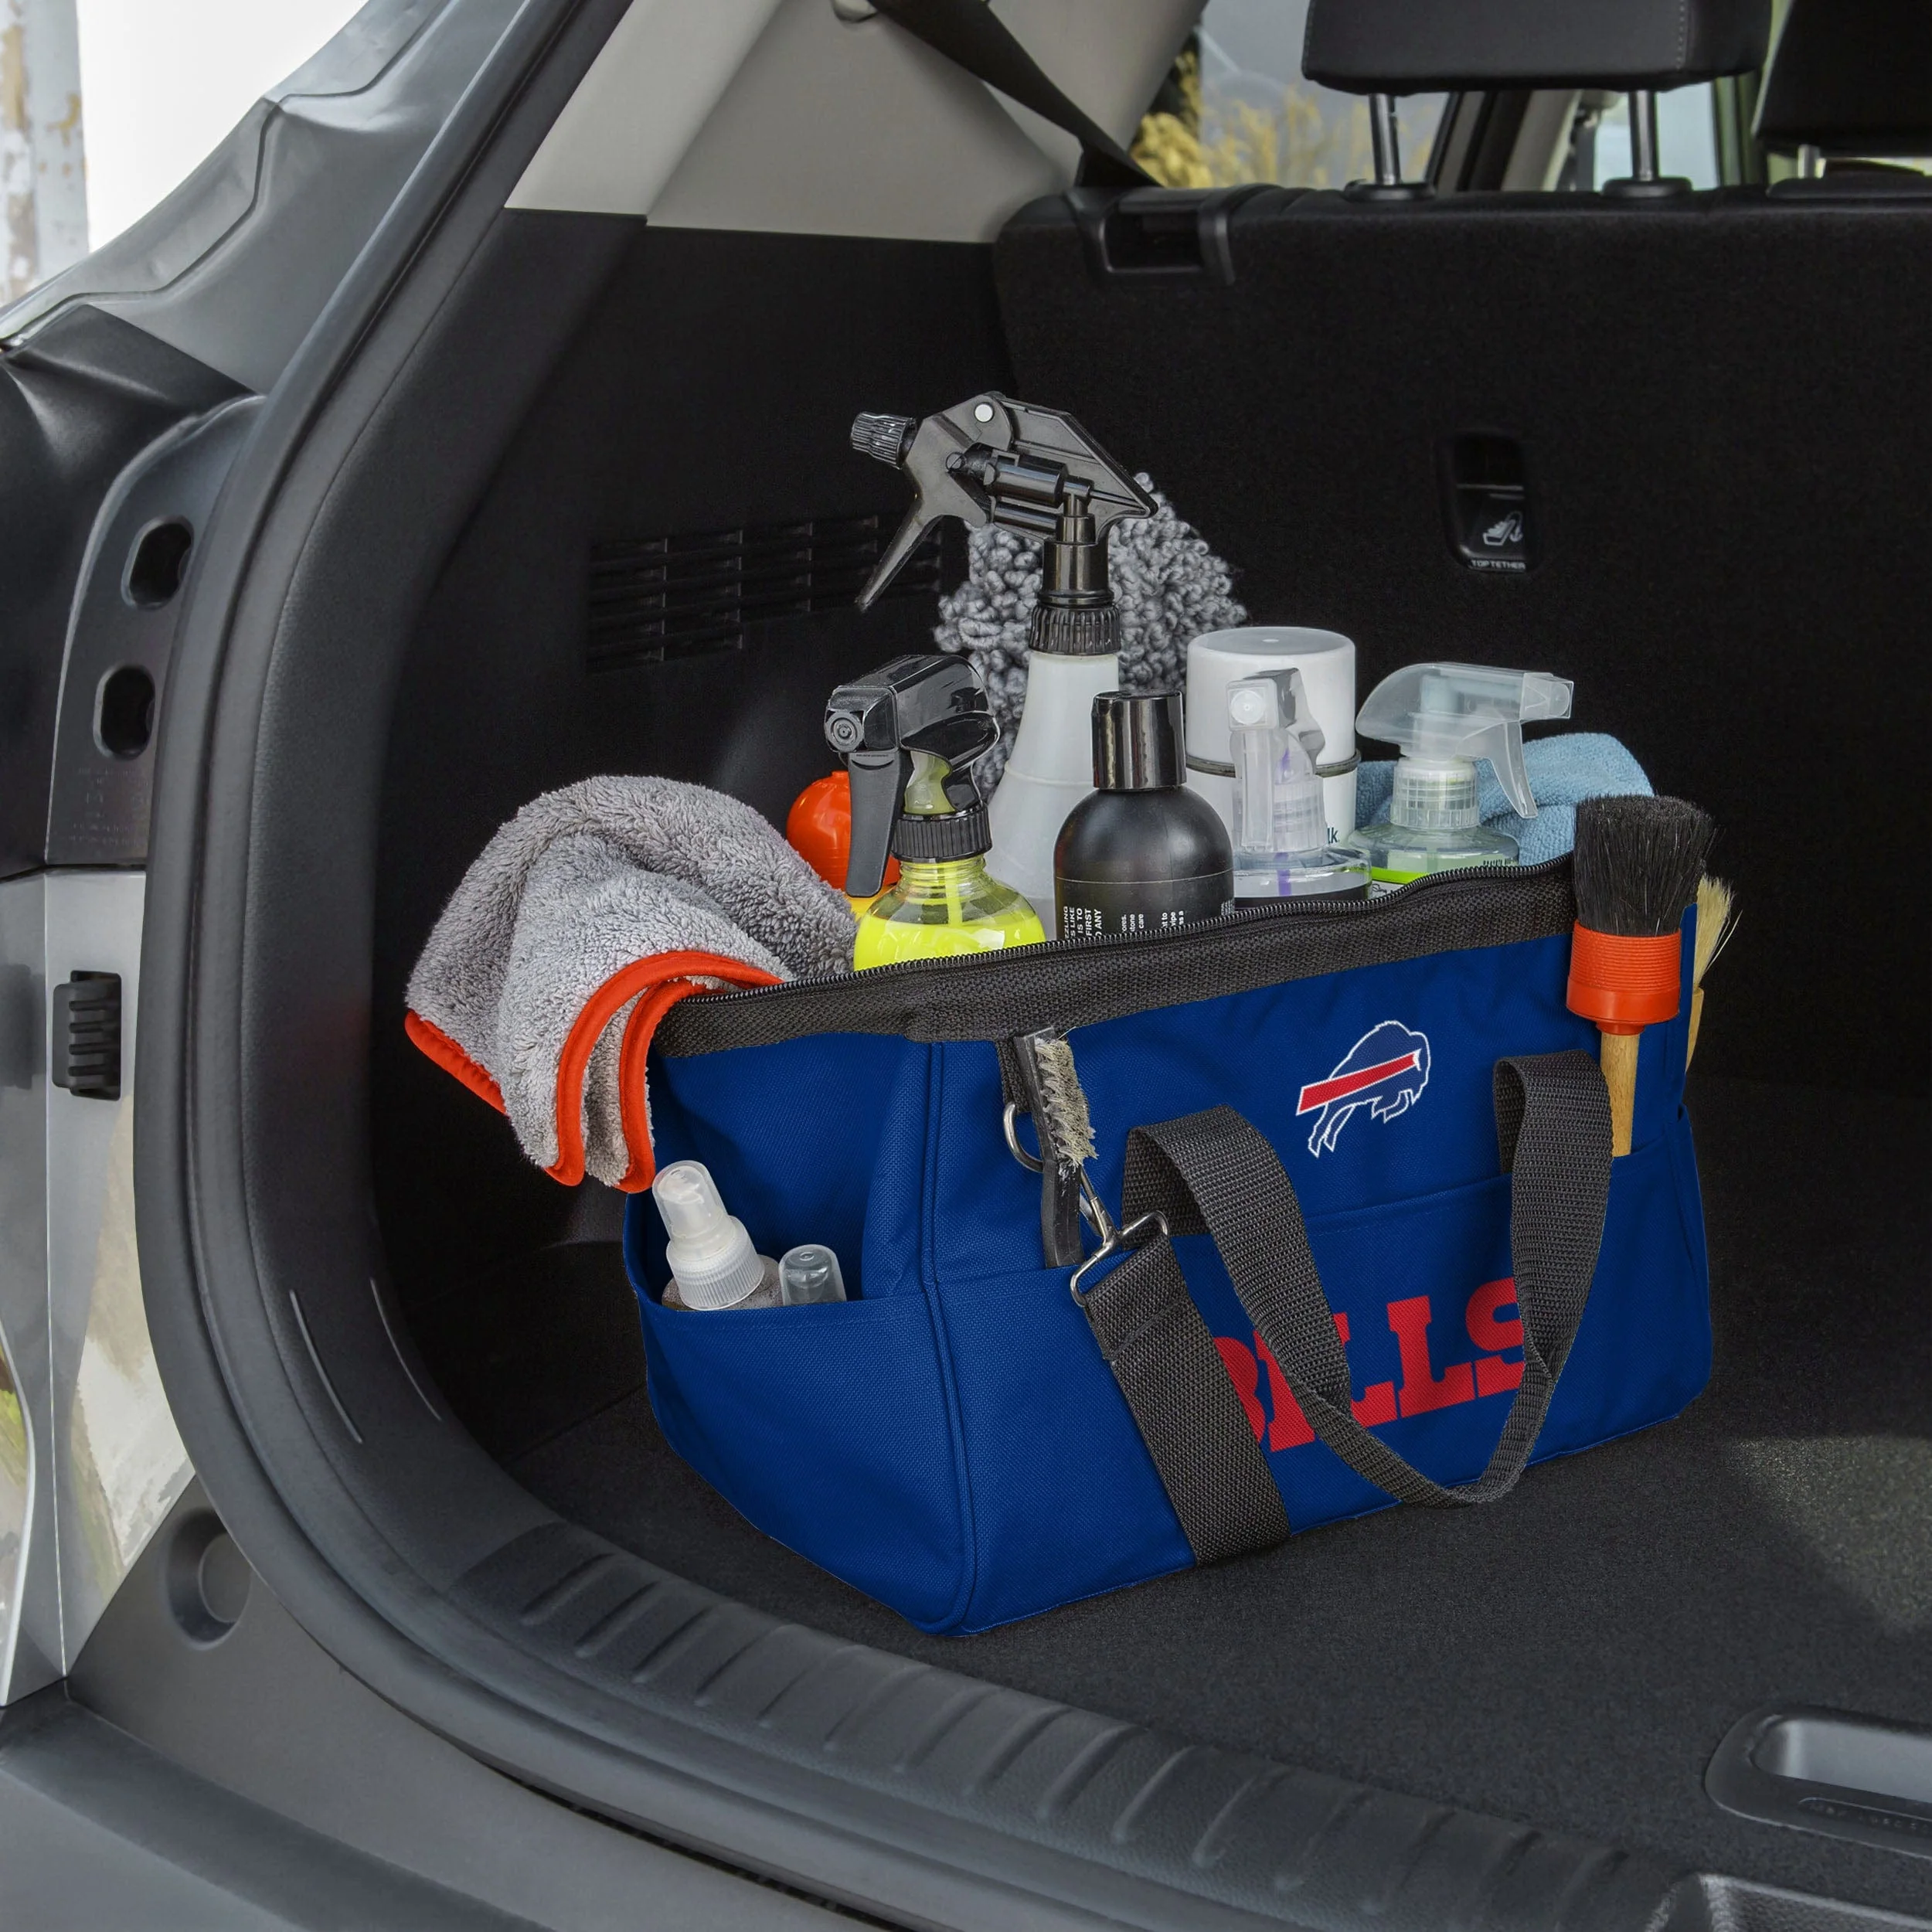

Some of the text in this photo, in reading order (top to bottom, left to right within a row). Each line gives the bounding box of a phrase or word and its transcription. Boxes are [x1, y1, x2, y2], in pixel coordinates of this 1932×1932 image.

[1076, 907, 1083, 934] IS TO
[1084, 908, 1093, 936] FIRST
[1094, 909, 1102, 930] ANY
[1161, 912, 1168, 920] to
